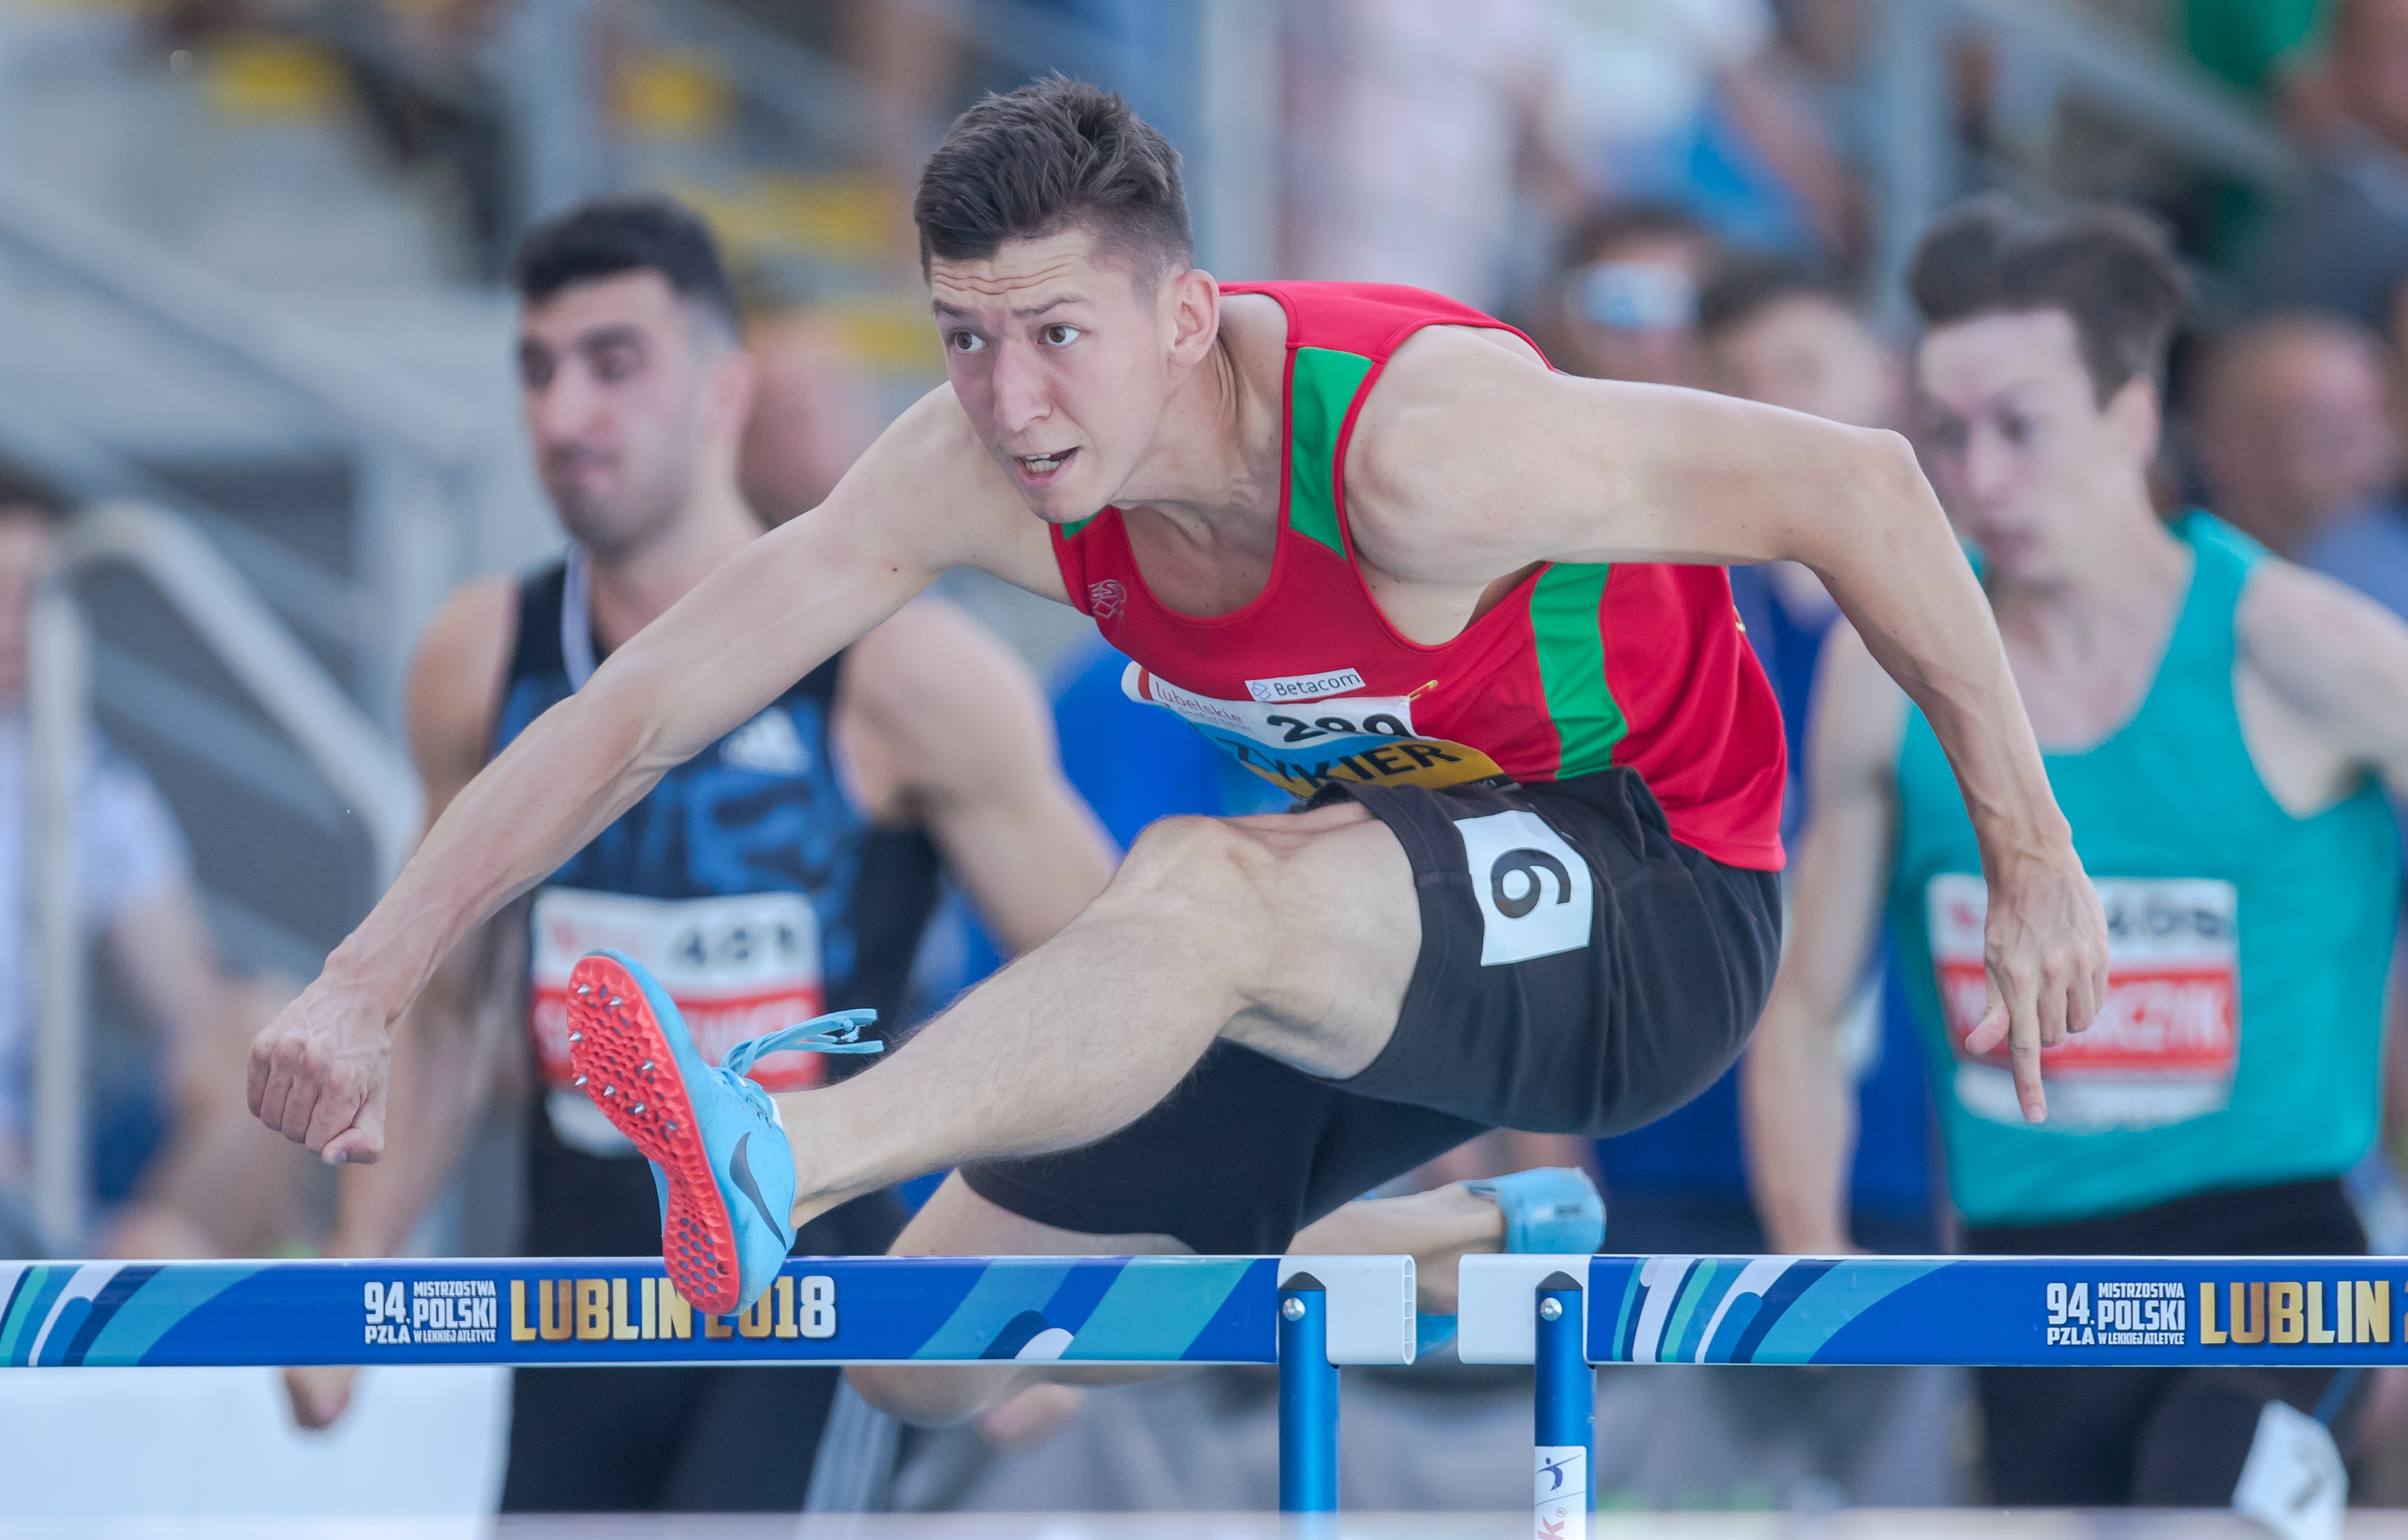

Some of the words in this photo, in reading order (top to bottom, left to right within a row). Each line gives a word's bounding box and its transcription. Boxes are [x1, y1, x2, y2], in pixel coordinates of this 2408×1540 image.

[1273, 673, 1360, 696] Betacom
[413, 1280, 496, 1298] MISTRZOSTWA
[2098, 1282, 2185, 1298] MISTRZOSTWA
[364, 1281, 411, 1325] 94.
[413, 1298, 497, 1329] POLSKI
[509, 1277, 692, 1341] LUBLIN
[2046, 1282, 2095, 1325] 94.
[2200, 1281, 2390, 1344] LUBLIN
[2098, 1300, 2185, 1330] POLSKI
[364, 1324, 411, 1345] PZLA
[413, 1329, 422, 1343] W
[423, 1329, 457, 1343] LEKKIEJ
[457, 1329, 496, 1343] ATLETYCE
[2046, 1327, 2096, 1345] PZLA
[2098, 1332, 2107, 1345] W
[2108, 1332, 2144, 1345] LEKKIEJ
[2145, 1332, 2185, 1345] ATLETYCE
